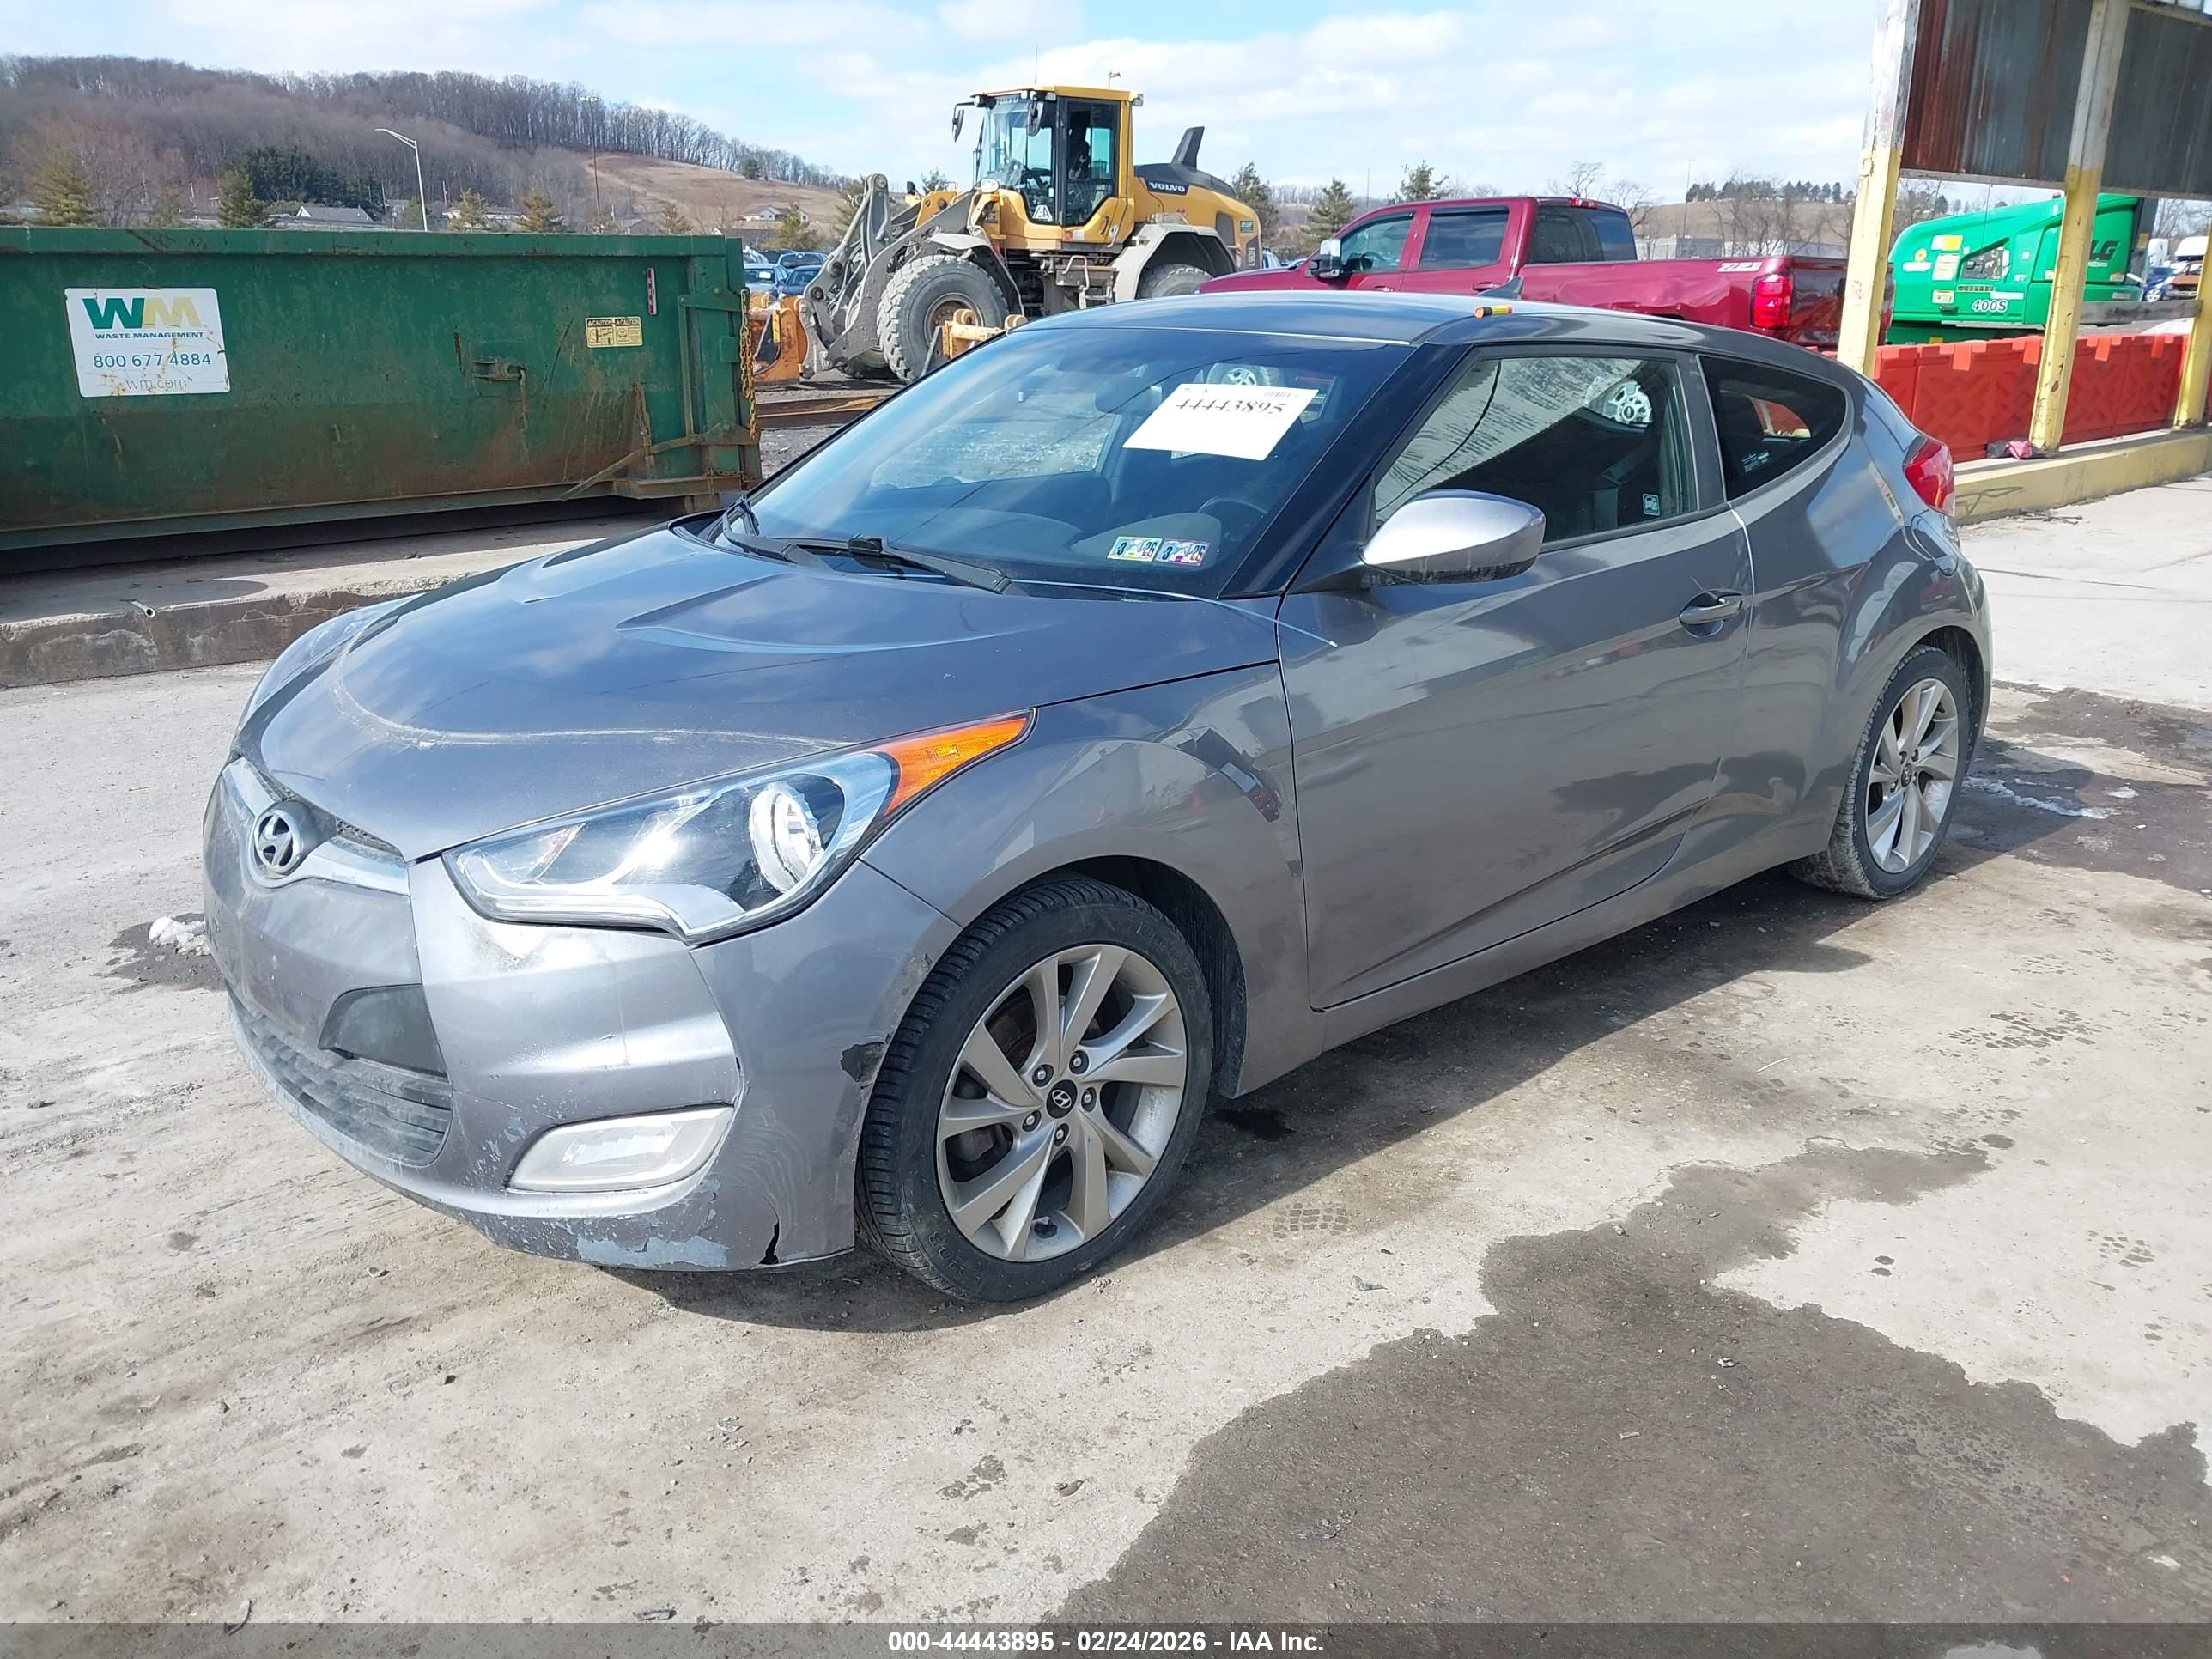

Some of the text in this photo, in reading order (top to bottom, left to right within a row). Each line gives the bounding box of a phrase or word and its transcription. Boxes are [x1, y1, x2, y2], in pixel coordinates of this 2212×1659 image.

[1149, 181, 1186, 193] VOLVO
[2088, 240, 2121, 260] LG
[82, 297, 204, 330] WM
[1972, 300, 2008, 313] 400S
[94, 353, 212, 368] 800 677 4884
[126, 378, 188, 391] wm.com
[1176, 398, 1287, 414] 44443895
[1117, 542, 1127, 556] 3
[1162, 546, 1173, 560] 3
